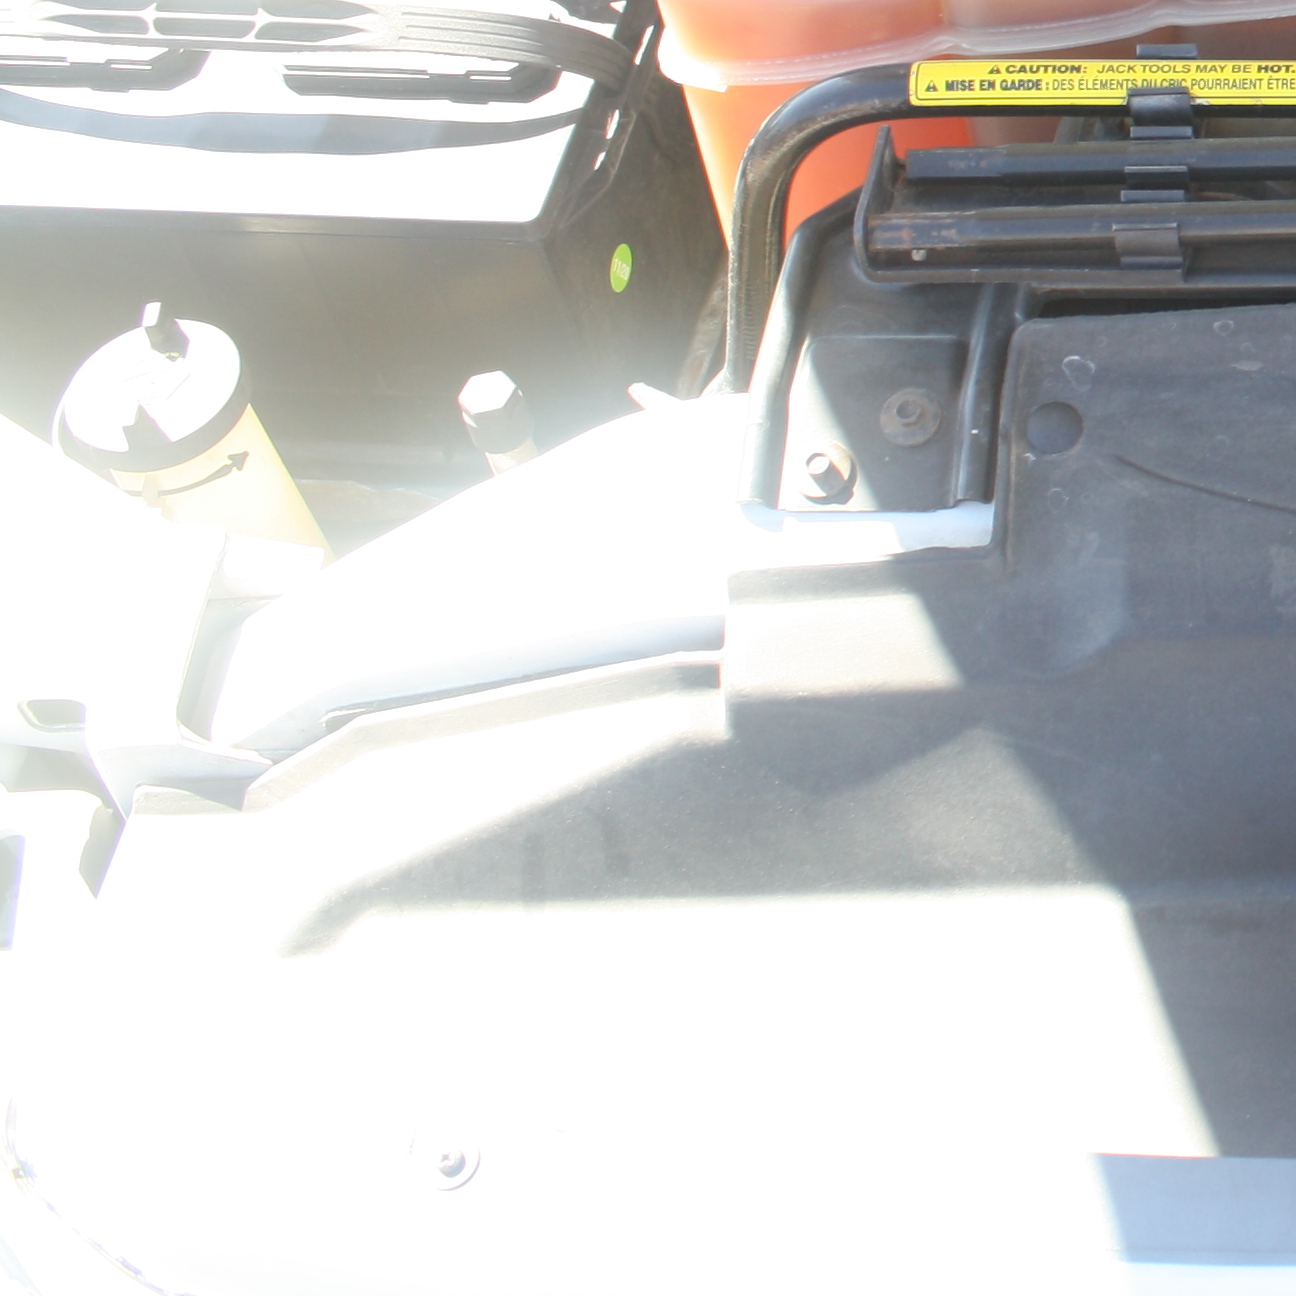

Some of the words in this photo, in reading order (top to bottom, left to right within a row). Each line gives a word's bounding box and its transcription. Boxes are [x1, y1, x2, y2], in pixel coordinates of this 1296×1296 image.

[1005, 64, 1088, 74] CAUTION:
[1096, 64, 1136, 74] JACK
[1140, 64, 1191, 74] TOOLS
[1195, 64, 1228, 73] MAY
[1232, 64, 1253, 73] BE
[1257, 64, 1296, 74] HOT.
[945, 79, 975, 91] MISE
[979, 79, 996, 91] EN
[1000, 79, 1042, 91] GARDE
[1052, 78, 1074, 90] DES
[1078, 75, 1139, 91] ÉLÉMENTS
[1159, 78, 1187, 87] CRIC
[1190, 78, 1263, 90] POURRAIENT
[1267, 75, 1296, 90] ÊTRE
